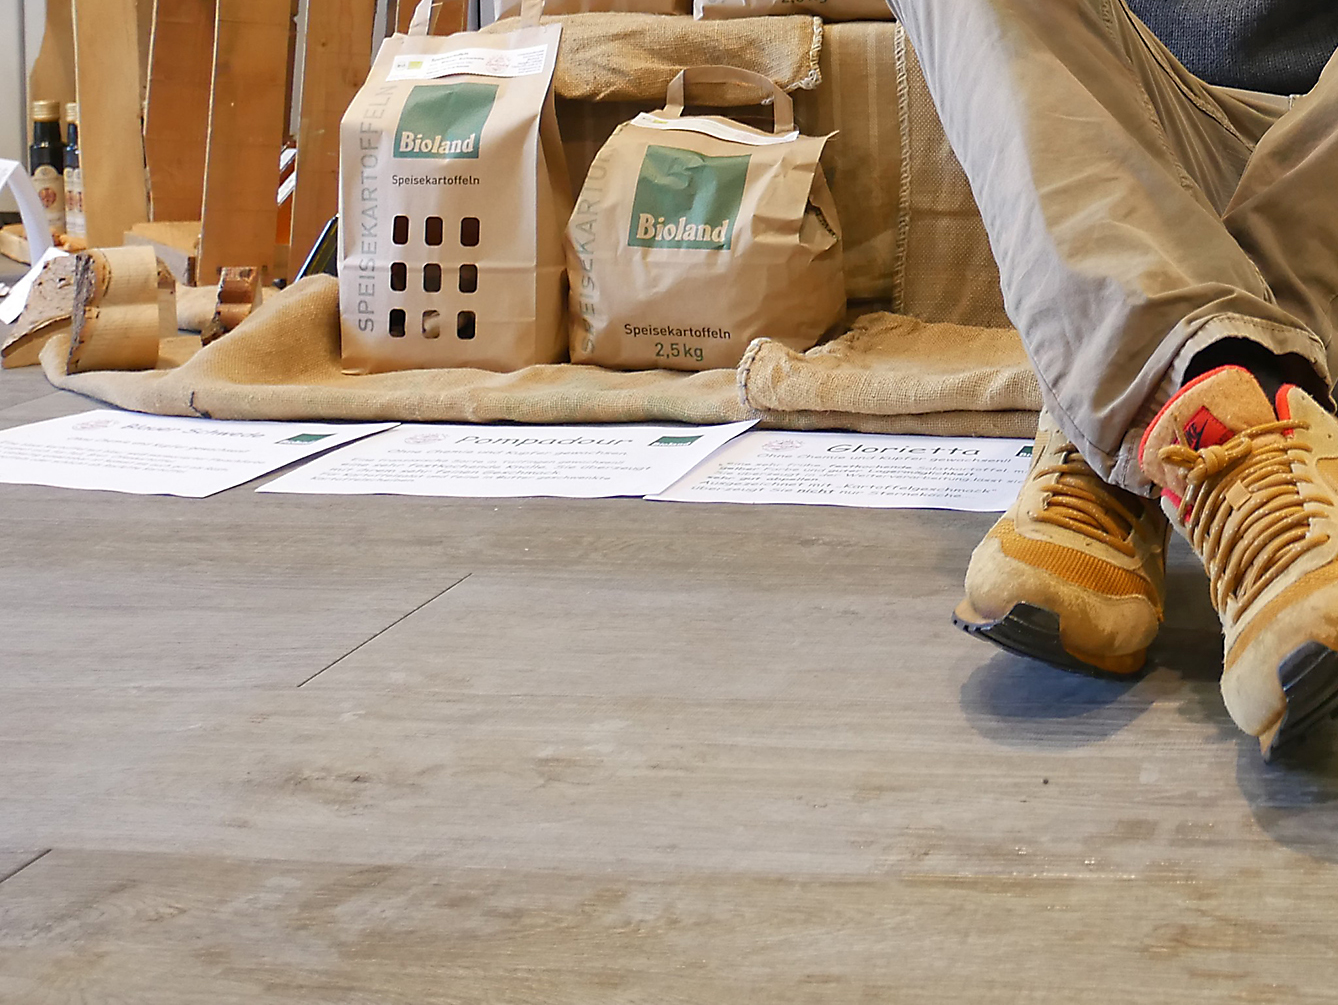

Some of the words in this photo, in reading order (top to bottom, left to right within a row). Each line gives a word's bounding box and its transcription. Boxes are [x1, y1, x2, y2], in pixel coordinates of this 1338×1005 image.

[398, 131, 476, 155] Bioland
[391, 173, 480, 188] Speisekartoffeln
[357, 85, 398, 333] SPEISEKARTOFFELN
[636, 214, 729, 245] Bioland
[623, 323, 732, 341] Speisekartoffeln
[654, 342, 681, 359] 2,5
[683, 343, 704, 362] kg
[455, 435, 634, 447] Pompadour
[827, 443, 981, 455] Glorietta
[867, 469, 975, 477] Lagermöglichkeit
[699, 480, 804, 488] Ausgezeichnet
